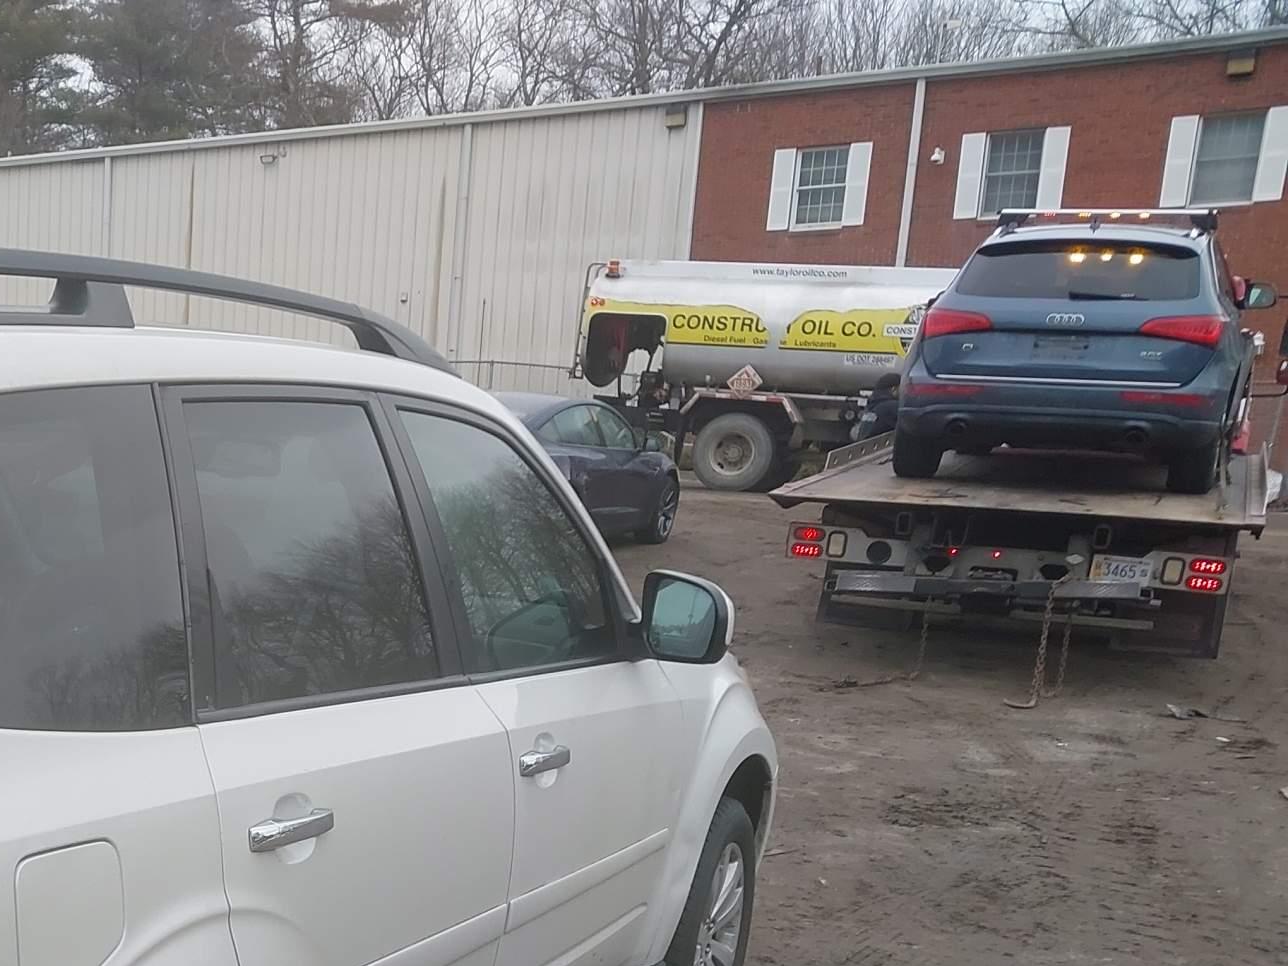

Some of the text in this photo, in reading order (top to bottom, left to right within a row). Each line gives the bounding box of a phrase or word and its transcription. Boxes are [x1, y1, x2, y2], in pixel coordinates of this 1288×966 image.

[752, 267, 848, 279] www.tayloroilco.com
[801, 319, 834, 336] OIL
[841, 321, 876, 337] CO.
[703, 335, 728, 344] Diesel
[729, 335, 746, 345] Fuel
[794, 339, 837, 349] Lubricants
[1103, 562, 1137, 579] 3465
